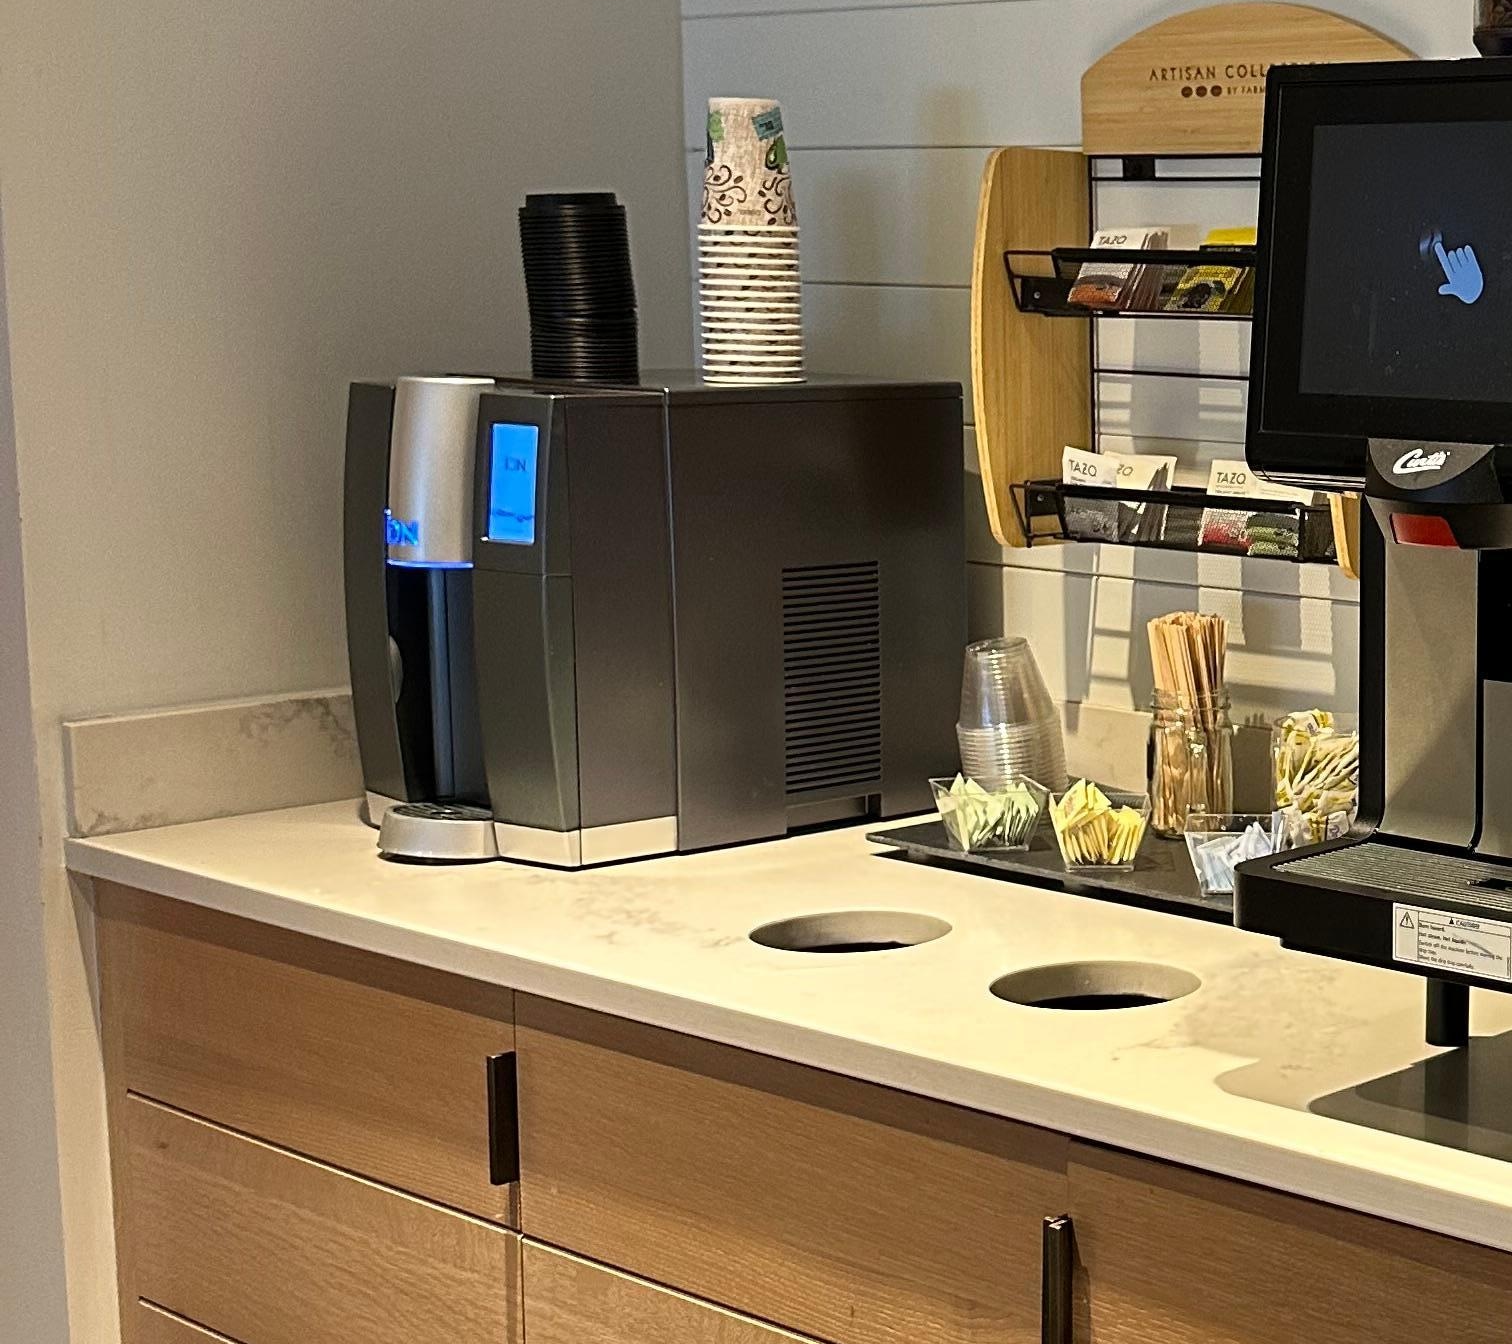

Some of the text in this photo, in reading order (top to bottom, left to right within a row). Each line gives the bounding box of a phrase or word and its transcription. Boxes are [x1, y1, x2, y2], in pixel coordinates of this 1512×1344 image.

[1149, 63, 1266, 81] ARTISAN COLL
[1068, 458, 1098, 477] TAZO
[1216, 471, 1246, 485] TAZO
